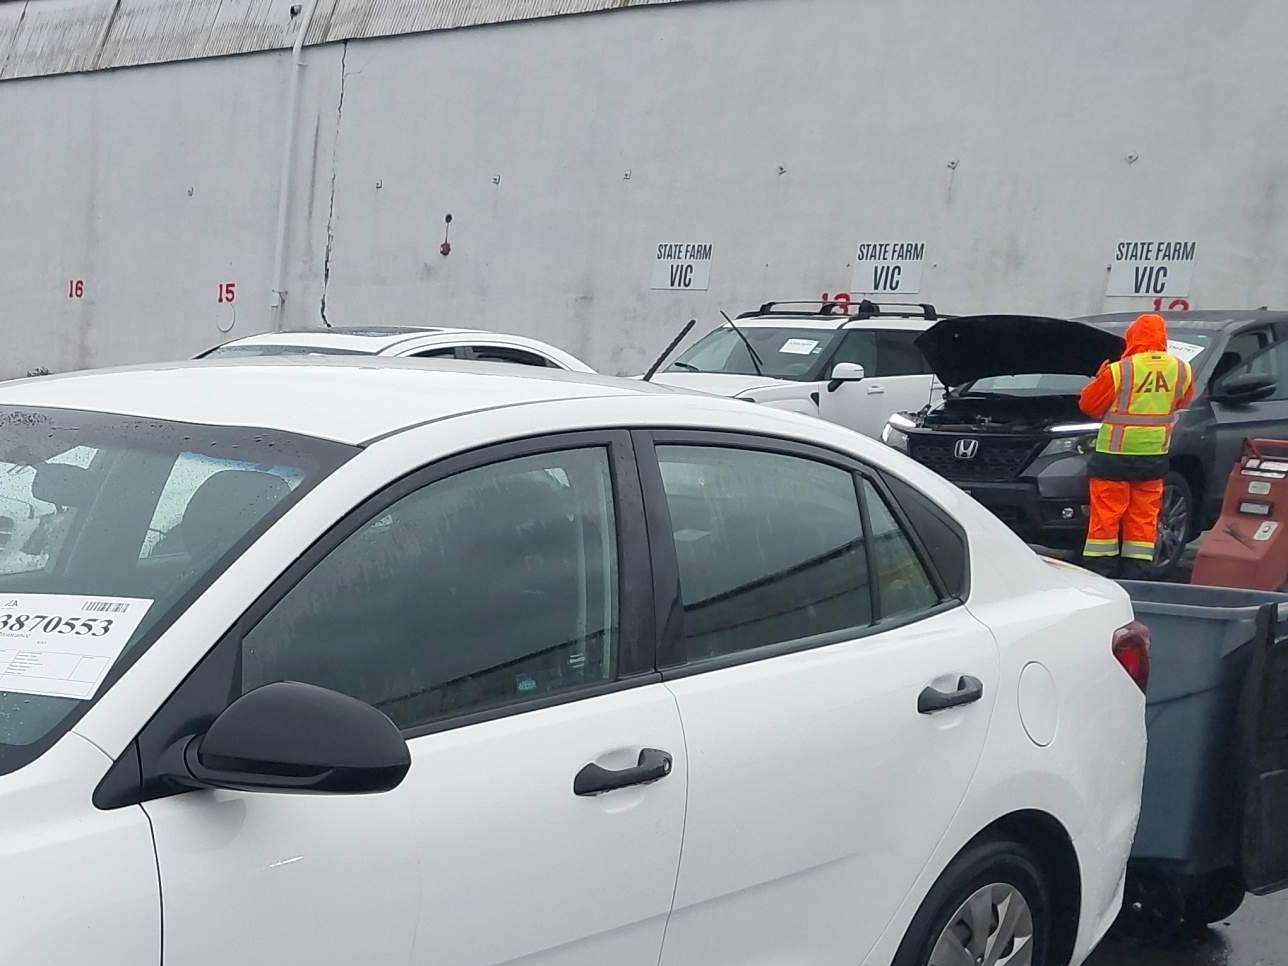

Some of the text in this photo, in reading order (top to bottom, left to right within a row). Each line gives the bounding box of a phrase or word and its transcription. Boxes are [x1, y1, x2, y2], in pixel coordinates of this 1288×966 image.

[657, 244, 712, 260] STATE FARM
[858, 243, 925, 260] STATE FARM
[1116, 242, 1196, 260] STATE FARM
[670, 264, 693, 287] VIC
[873, 265, 901, 290] VIC
[1134, 266, 1167, 294] VIC
[68, 280, 83, 298] 16
[217, 283, 235, 302] 15
